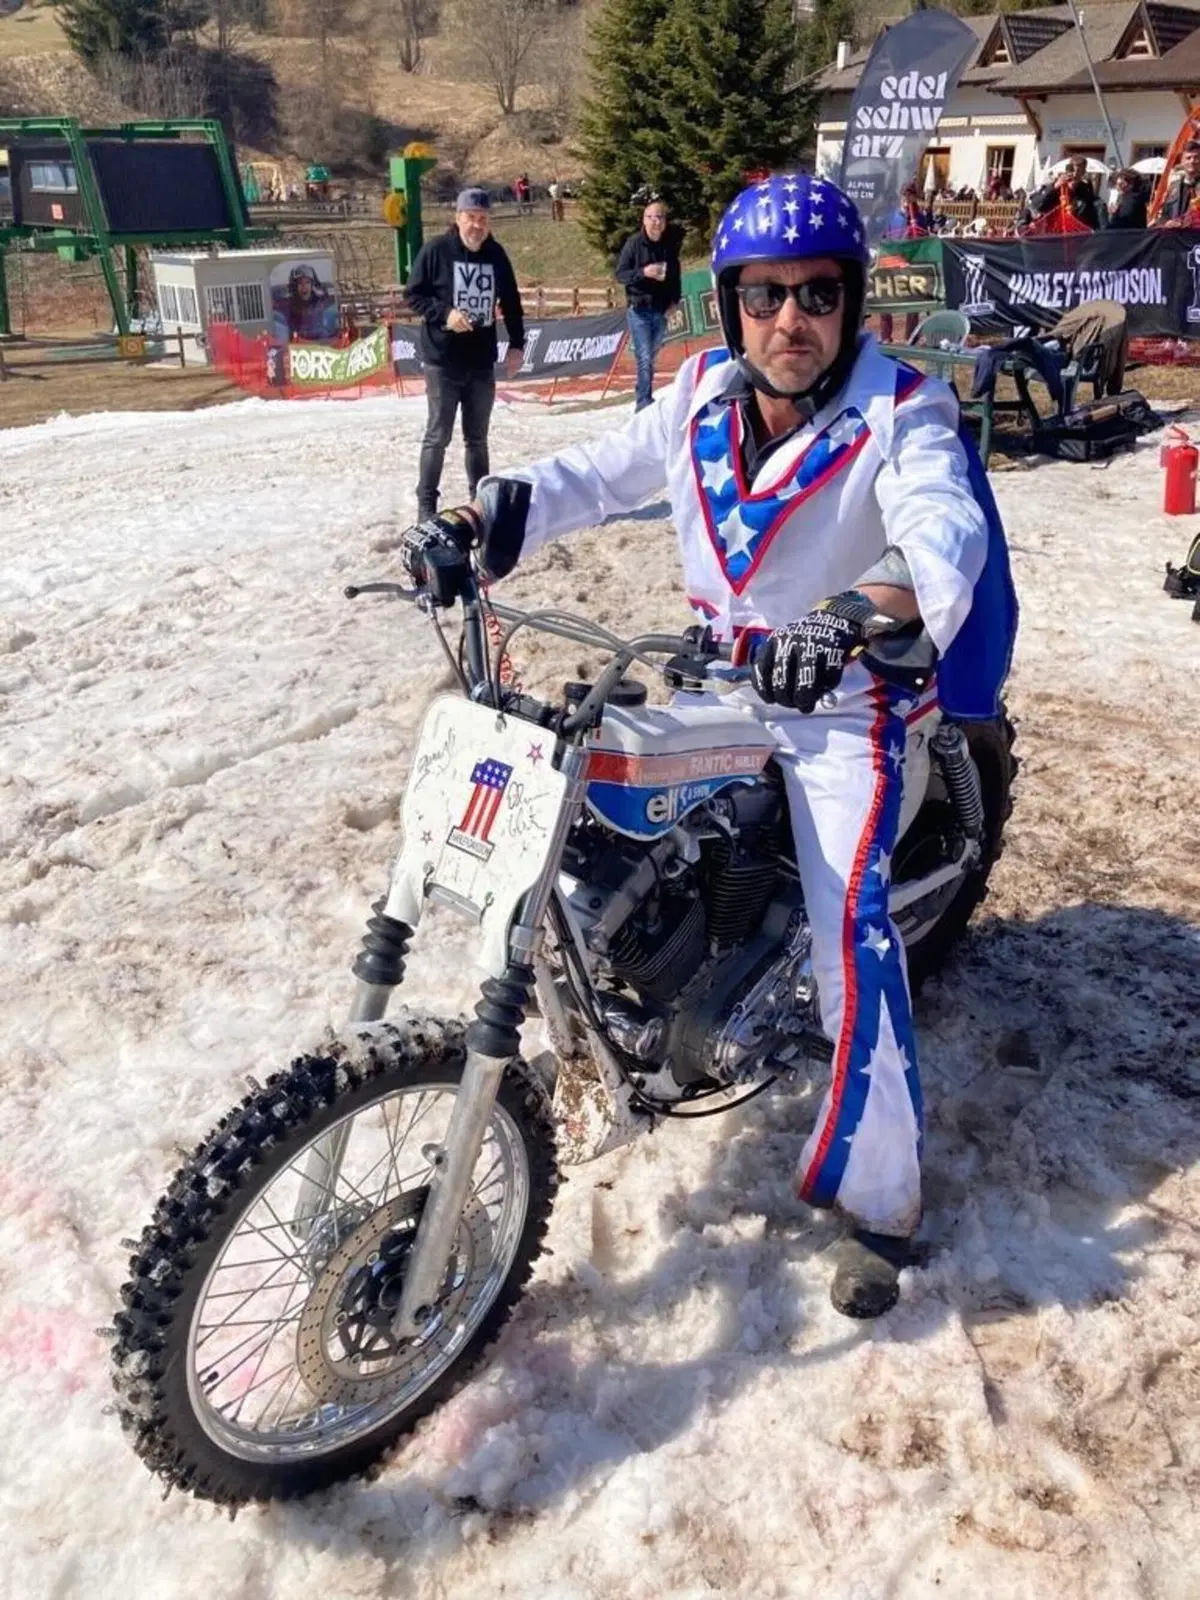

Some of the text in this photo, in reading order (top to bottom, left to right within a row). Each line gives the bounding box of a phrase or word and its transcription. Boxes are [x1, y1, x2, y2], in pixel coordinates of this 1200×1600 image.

[880, 70, 948, 100] edel
[855, 101, 943, 131] schw
[851, 133, 905, 159] arz
[458, 266, 492, 291] Va
[457, 290, 491, 308] Fan
[289, 349, 341, 379] FORST
